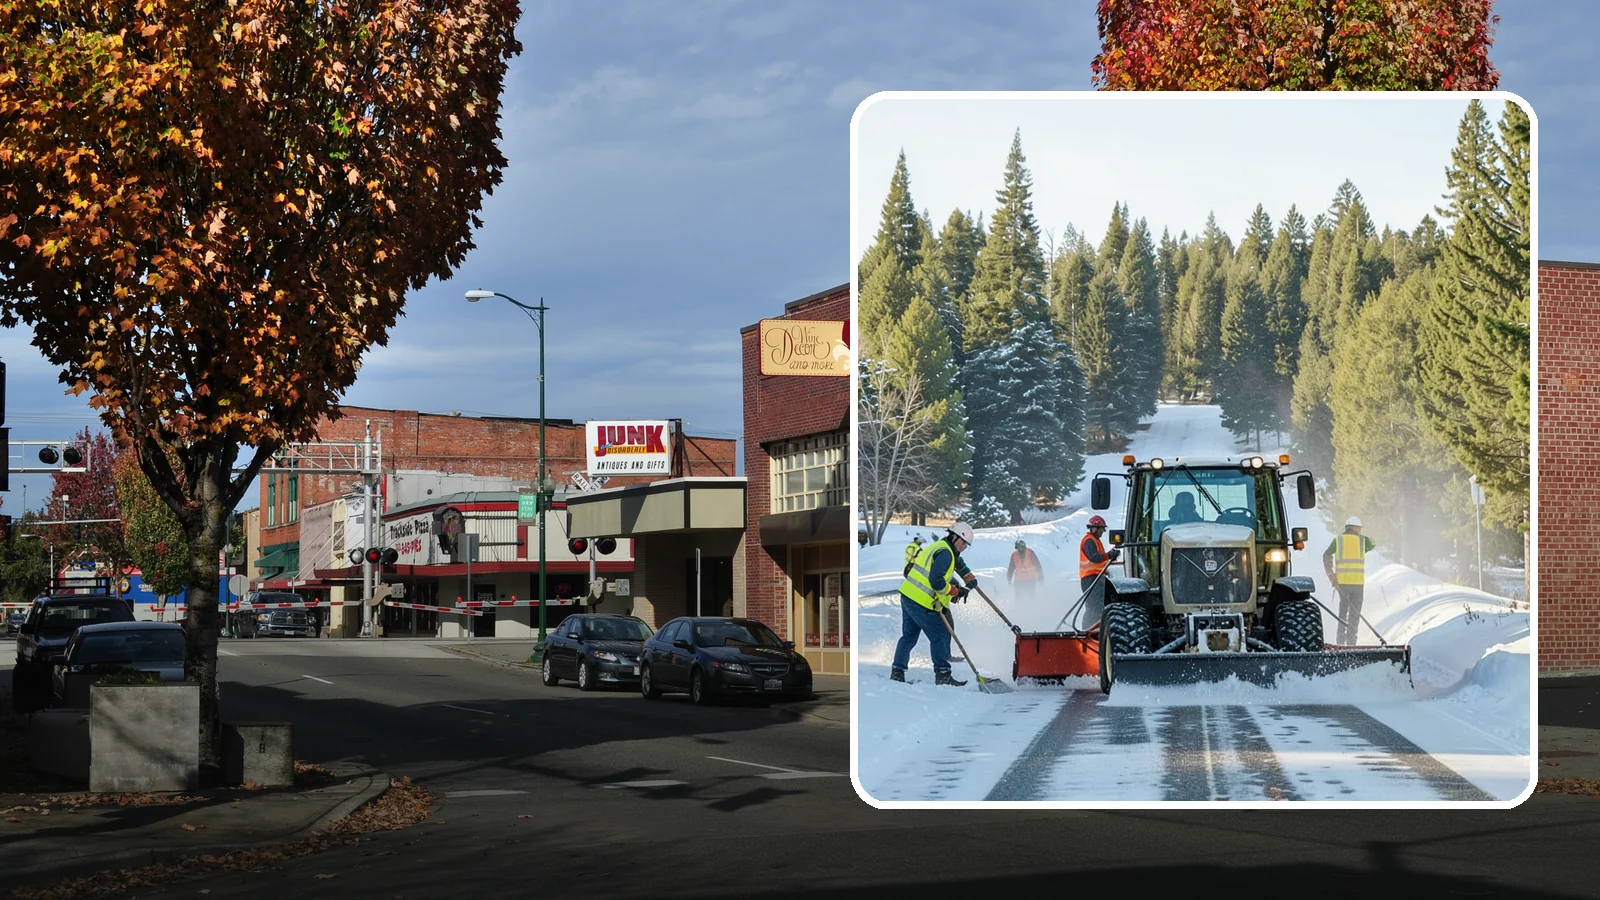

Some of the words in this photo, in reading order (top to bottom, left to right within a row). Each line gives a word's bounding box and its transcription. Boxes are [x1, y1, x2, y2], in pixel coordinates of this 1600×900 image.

[595, 425, 665, 457] JUNK
[607, 446, 646, 454] DISORDERLY
[597, 461, 628, 470] ANTIQUES
[631, 461, 644, 470] AND
[647, 460, 665, 469] GIFTS
[415, 519, 429, 535] Pizza
